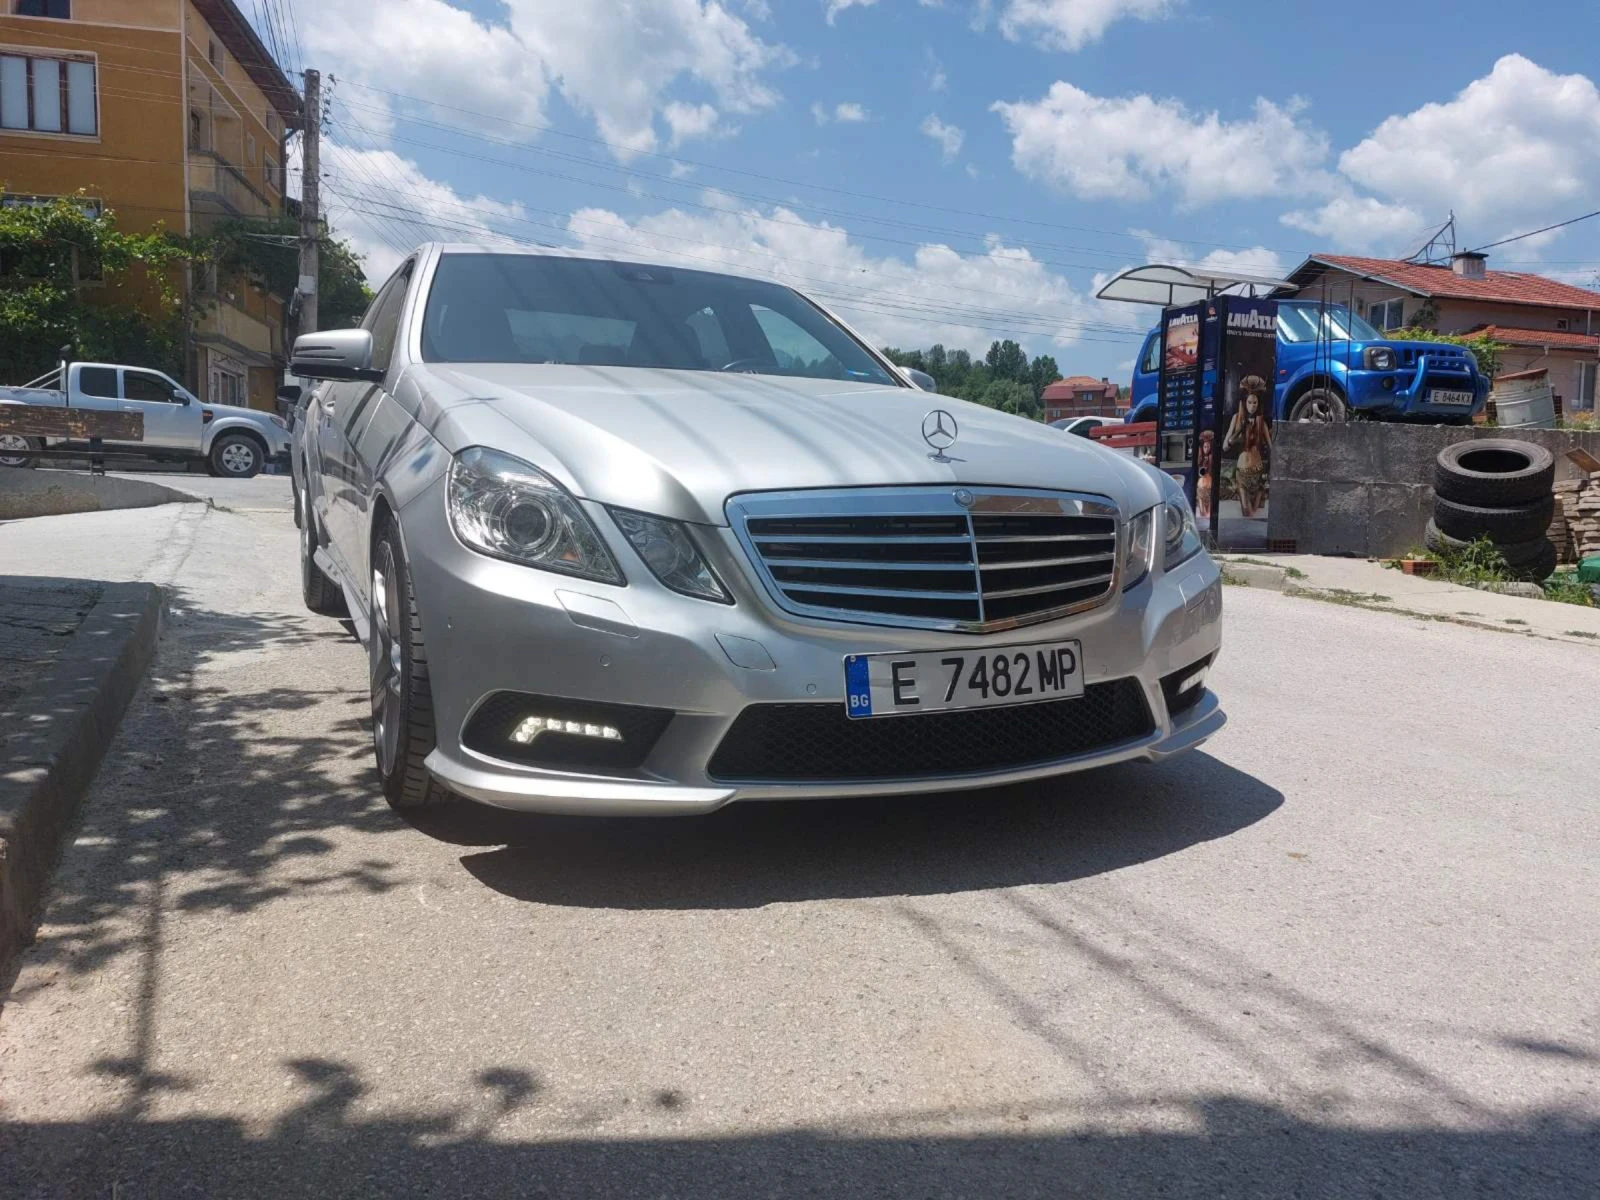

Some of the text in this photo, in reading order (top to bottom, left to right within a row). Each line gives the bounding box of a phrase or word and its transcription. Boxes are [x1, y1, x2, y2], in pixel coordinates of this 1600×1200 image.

[1169, 313, 1198, 327] LAVAZZA
[1227, 309, 1277, 330] LAVAZZA
[1433, 391, 1440, 402] E
[891, 660, 920, 706] E
[850, 694, 869, 708] BG
